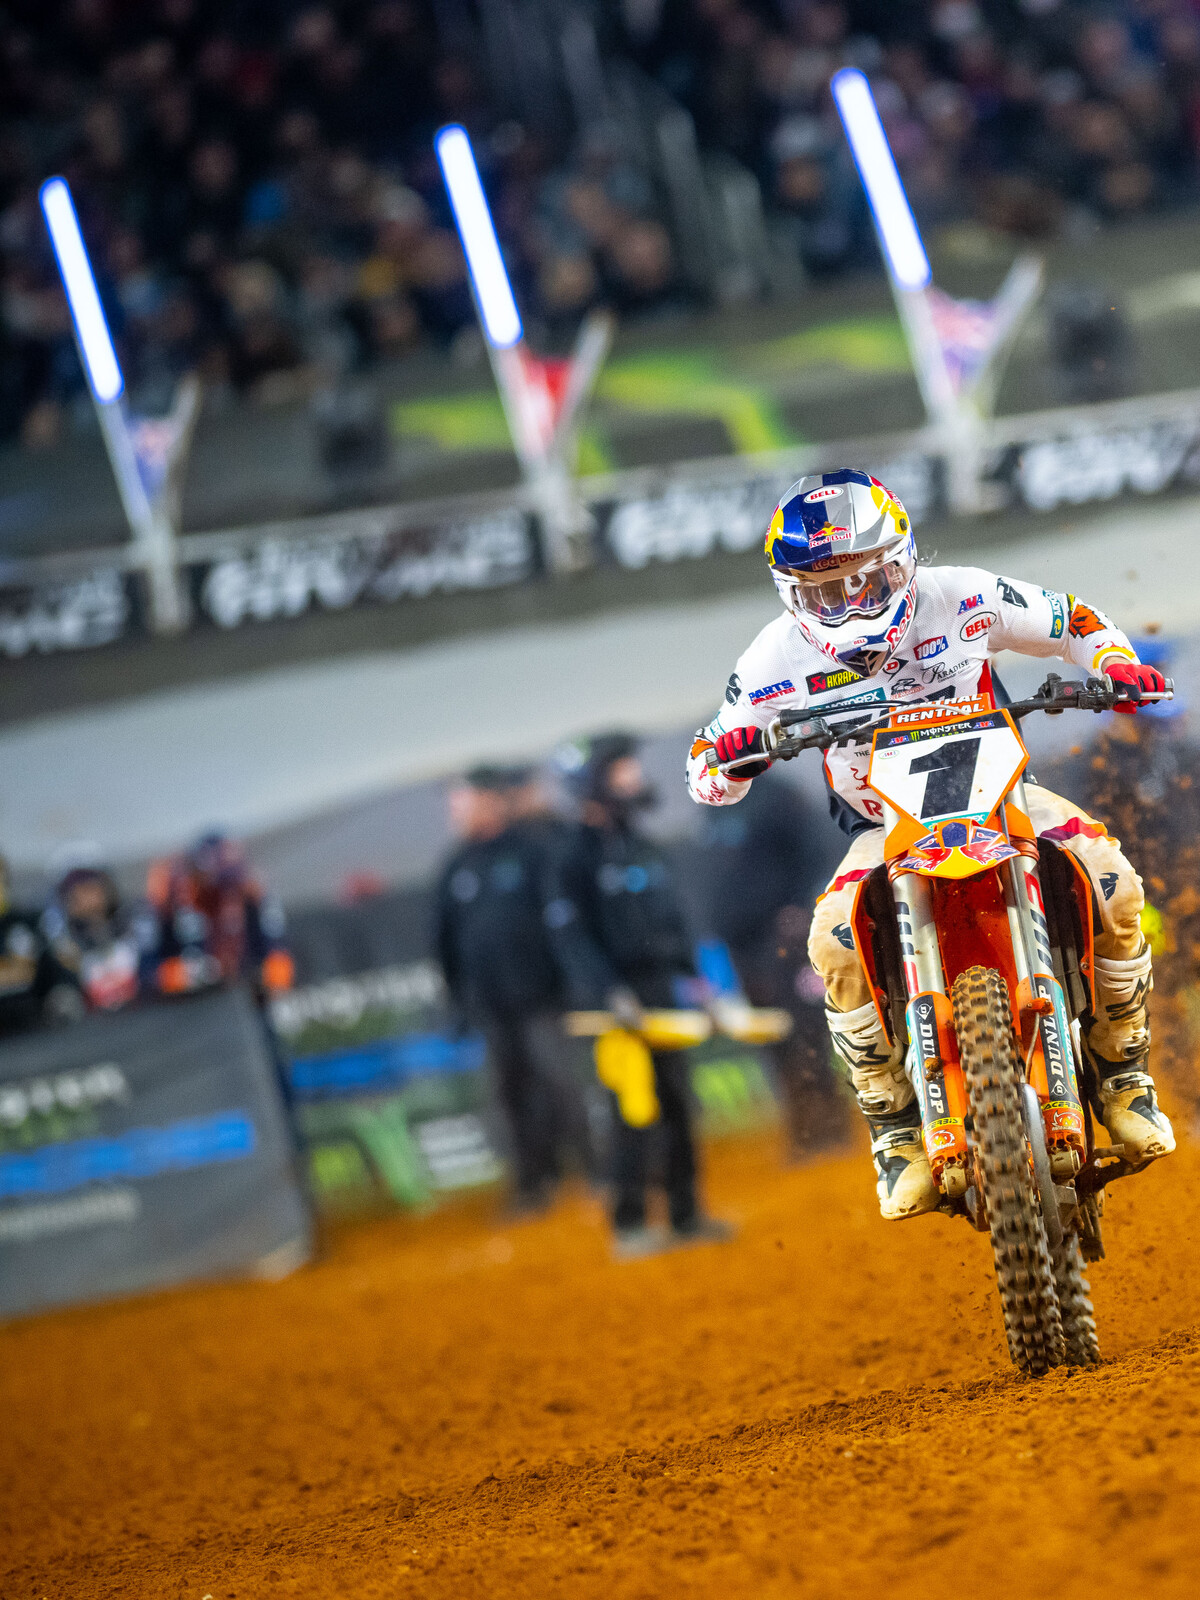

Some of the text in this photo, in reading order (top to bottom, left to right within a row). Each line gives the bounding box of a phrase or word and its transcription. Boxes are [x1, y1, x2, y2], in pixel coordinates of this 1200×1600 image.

[810, 488, 838, 501] BELL
[809, 532, 852, 549] Red Bull
[812, 555, 837, 572] Red
[957, 593, 985, 615] AMA
[885, 593, 914, 652] Red
[965, 617, 992, 638] BELL
[853, 638, 866, 646] BELL
[916, 637, 947, 659] 100%
[748, 679, 794, 702] PARTS
[751, 687, 796, 706] UNLIMITED
[896, 703, 984, 724] RENTHAL
[920, 721, 972, 737] MONSTER
[854, 749, 871, 758] THE
[908, 737, 981, 820] 1
[1038, 984, 1065, 1079] DUNLP
[919, 1022, 945, 1115] DUOP
